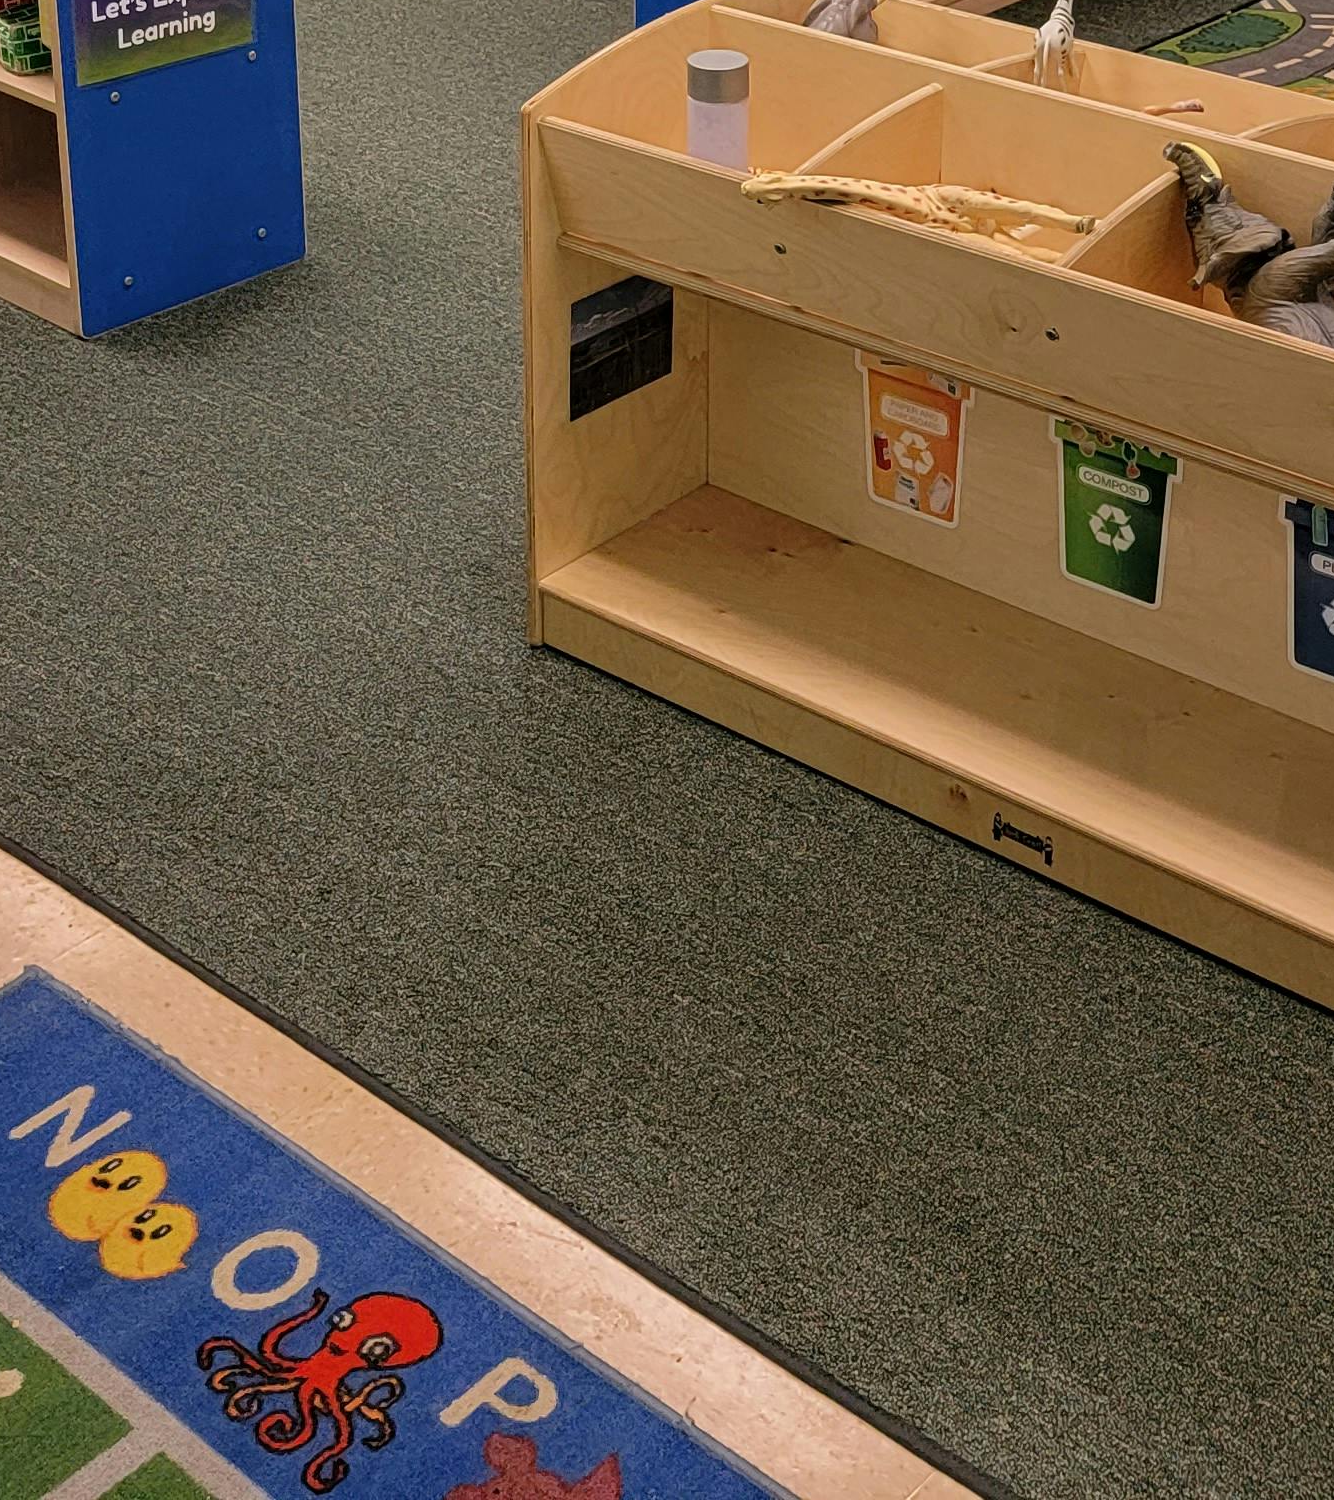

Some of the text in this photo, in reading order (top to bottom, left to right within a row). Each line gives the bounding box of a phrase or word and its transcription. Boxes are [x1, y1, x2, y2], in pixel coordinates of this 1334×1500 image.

[117, 10, 217, 50] Learning
[1081, 469, 1146, 500] COMPOST
[7, 1085, 558, 1428] N O P
